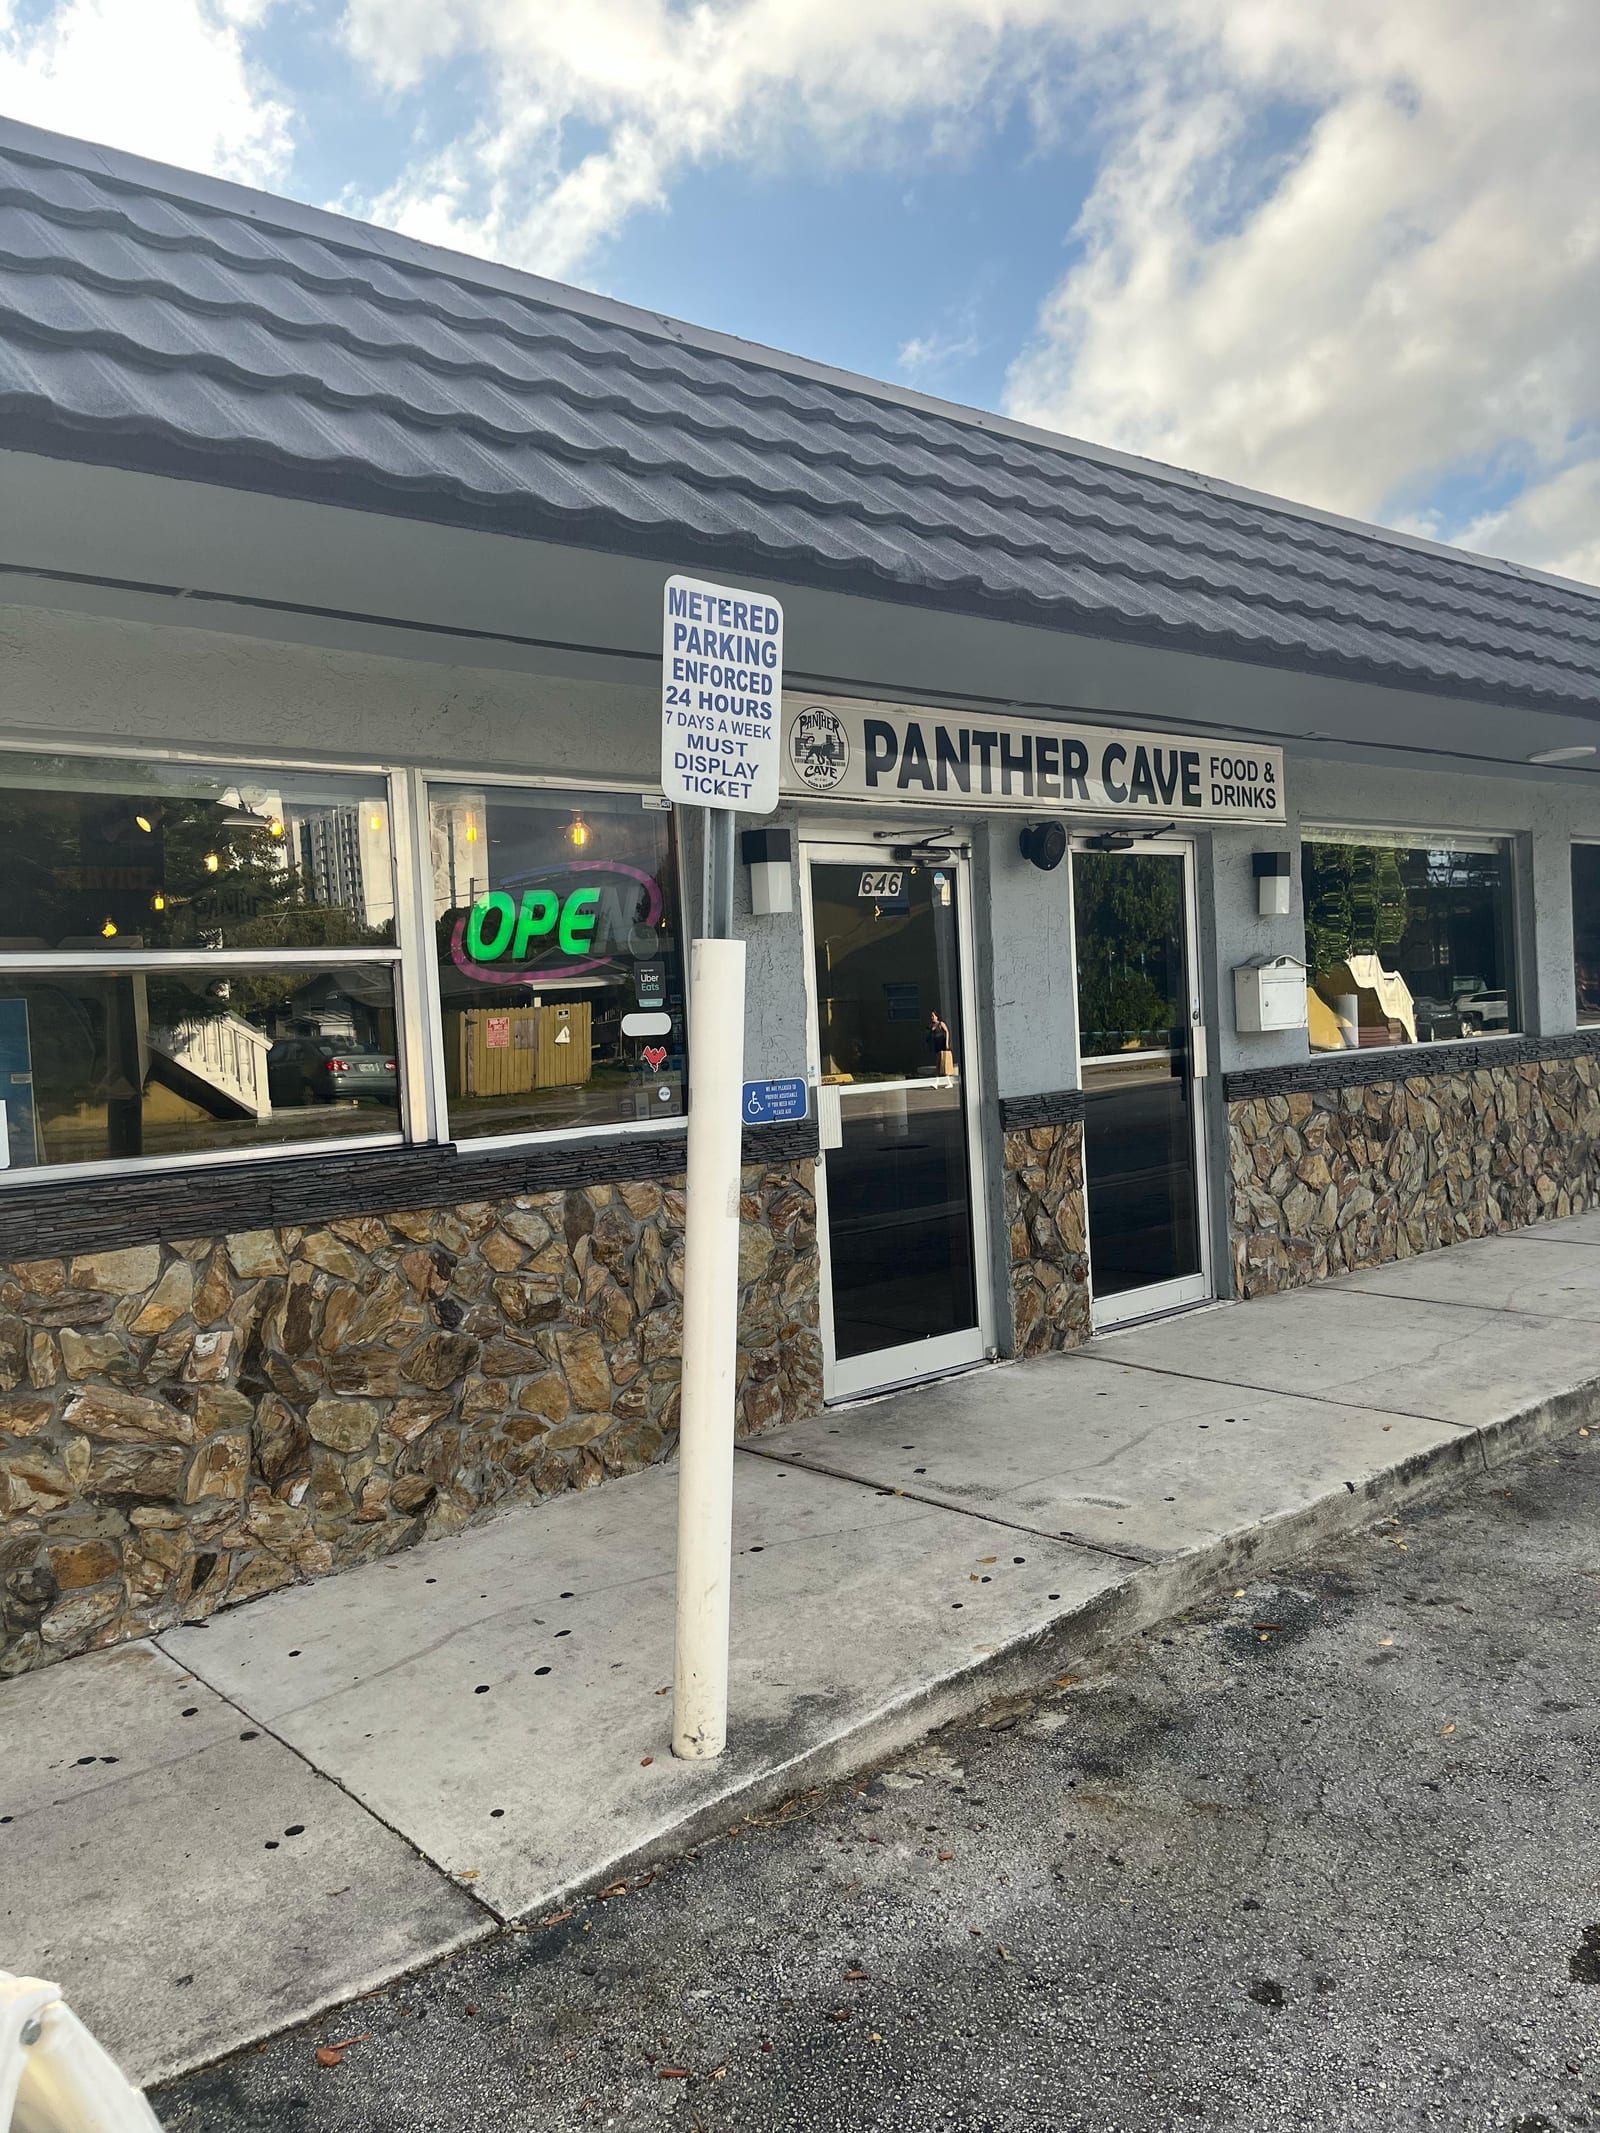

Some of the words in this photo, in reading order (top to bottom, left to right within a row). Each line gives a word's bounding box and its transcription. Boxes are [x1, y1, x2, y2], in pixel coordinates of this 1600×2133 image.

[669, 587, 779, 636] METERED
[674, 623, 777, 668] PARKING
[673, 658, 773, 695] ENFORCED
[666, 686, 691, 707] 24
[699, 691, 772, 720] HOURS
[665, 711, 673, 725] 7
[678, 713, 714, 731] DAYS
[718, 720, 728, 733] A
[731, 721, 771, 740] WEEK
[799, 711, 841, 743] PANTHER
[687, 734, 748, 757] MUST
[674, 753, 760, 780] DISPLAY
[804, 765, 837, 780] CAVE
[863, 718, 1090, 800] PANTHER
[1101, 742, 1202, 808] CAVE
[1210, 756, 1260, 783] FOOD
[1263, 761, 1276, 784] &
[682, 775, 752, 799] TICKET
[1210, 783, 1277, 810] DRINKS
[862, 873, 900, 894] 646
[467, 887, 642, 960] OPEN
[640, 974, 659, 982] Uber
[641, 983, 660, 991] Eats
